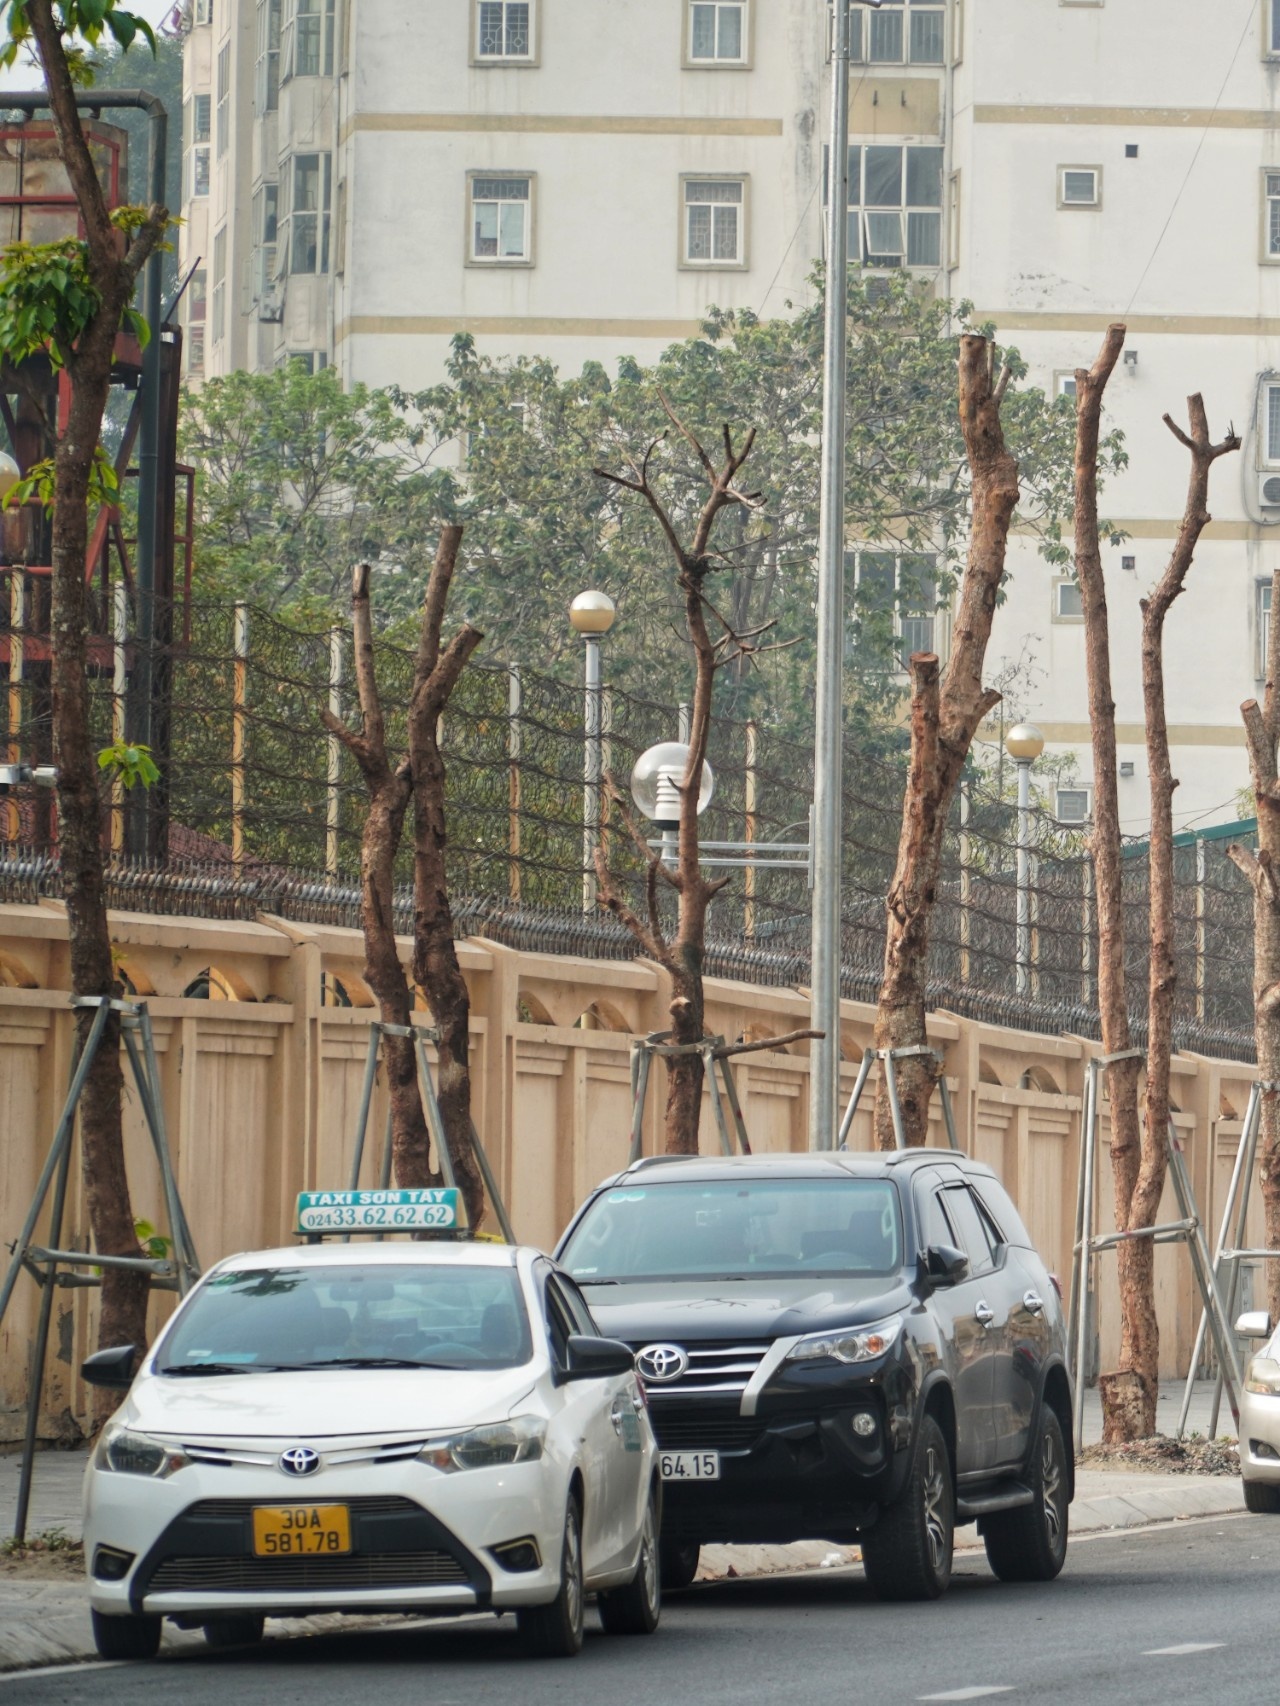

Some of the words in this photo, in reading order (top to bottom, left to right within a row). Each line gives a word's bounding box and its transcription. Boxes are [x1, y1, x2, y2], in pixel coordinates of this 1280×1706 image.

[307, 1193, 353, 1206] TAXI
[359, 1190, 401, 1205] SƠN
[407, 1189, 447, 1204] TÂY
[281, 1508, 321, 1529] 30A
[264, 1530, 340, 1553] 581.78
